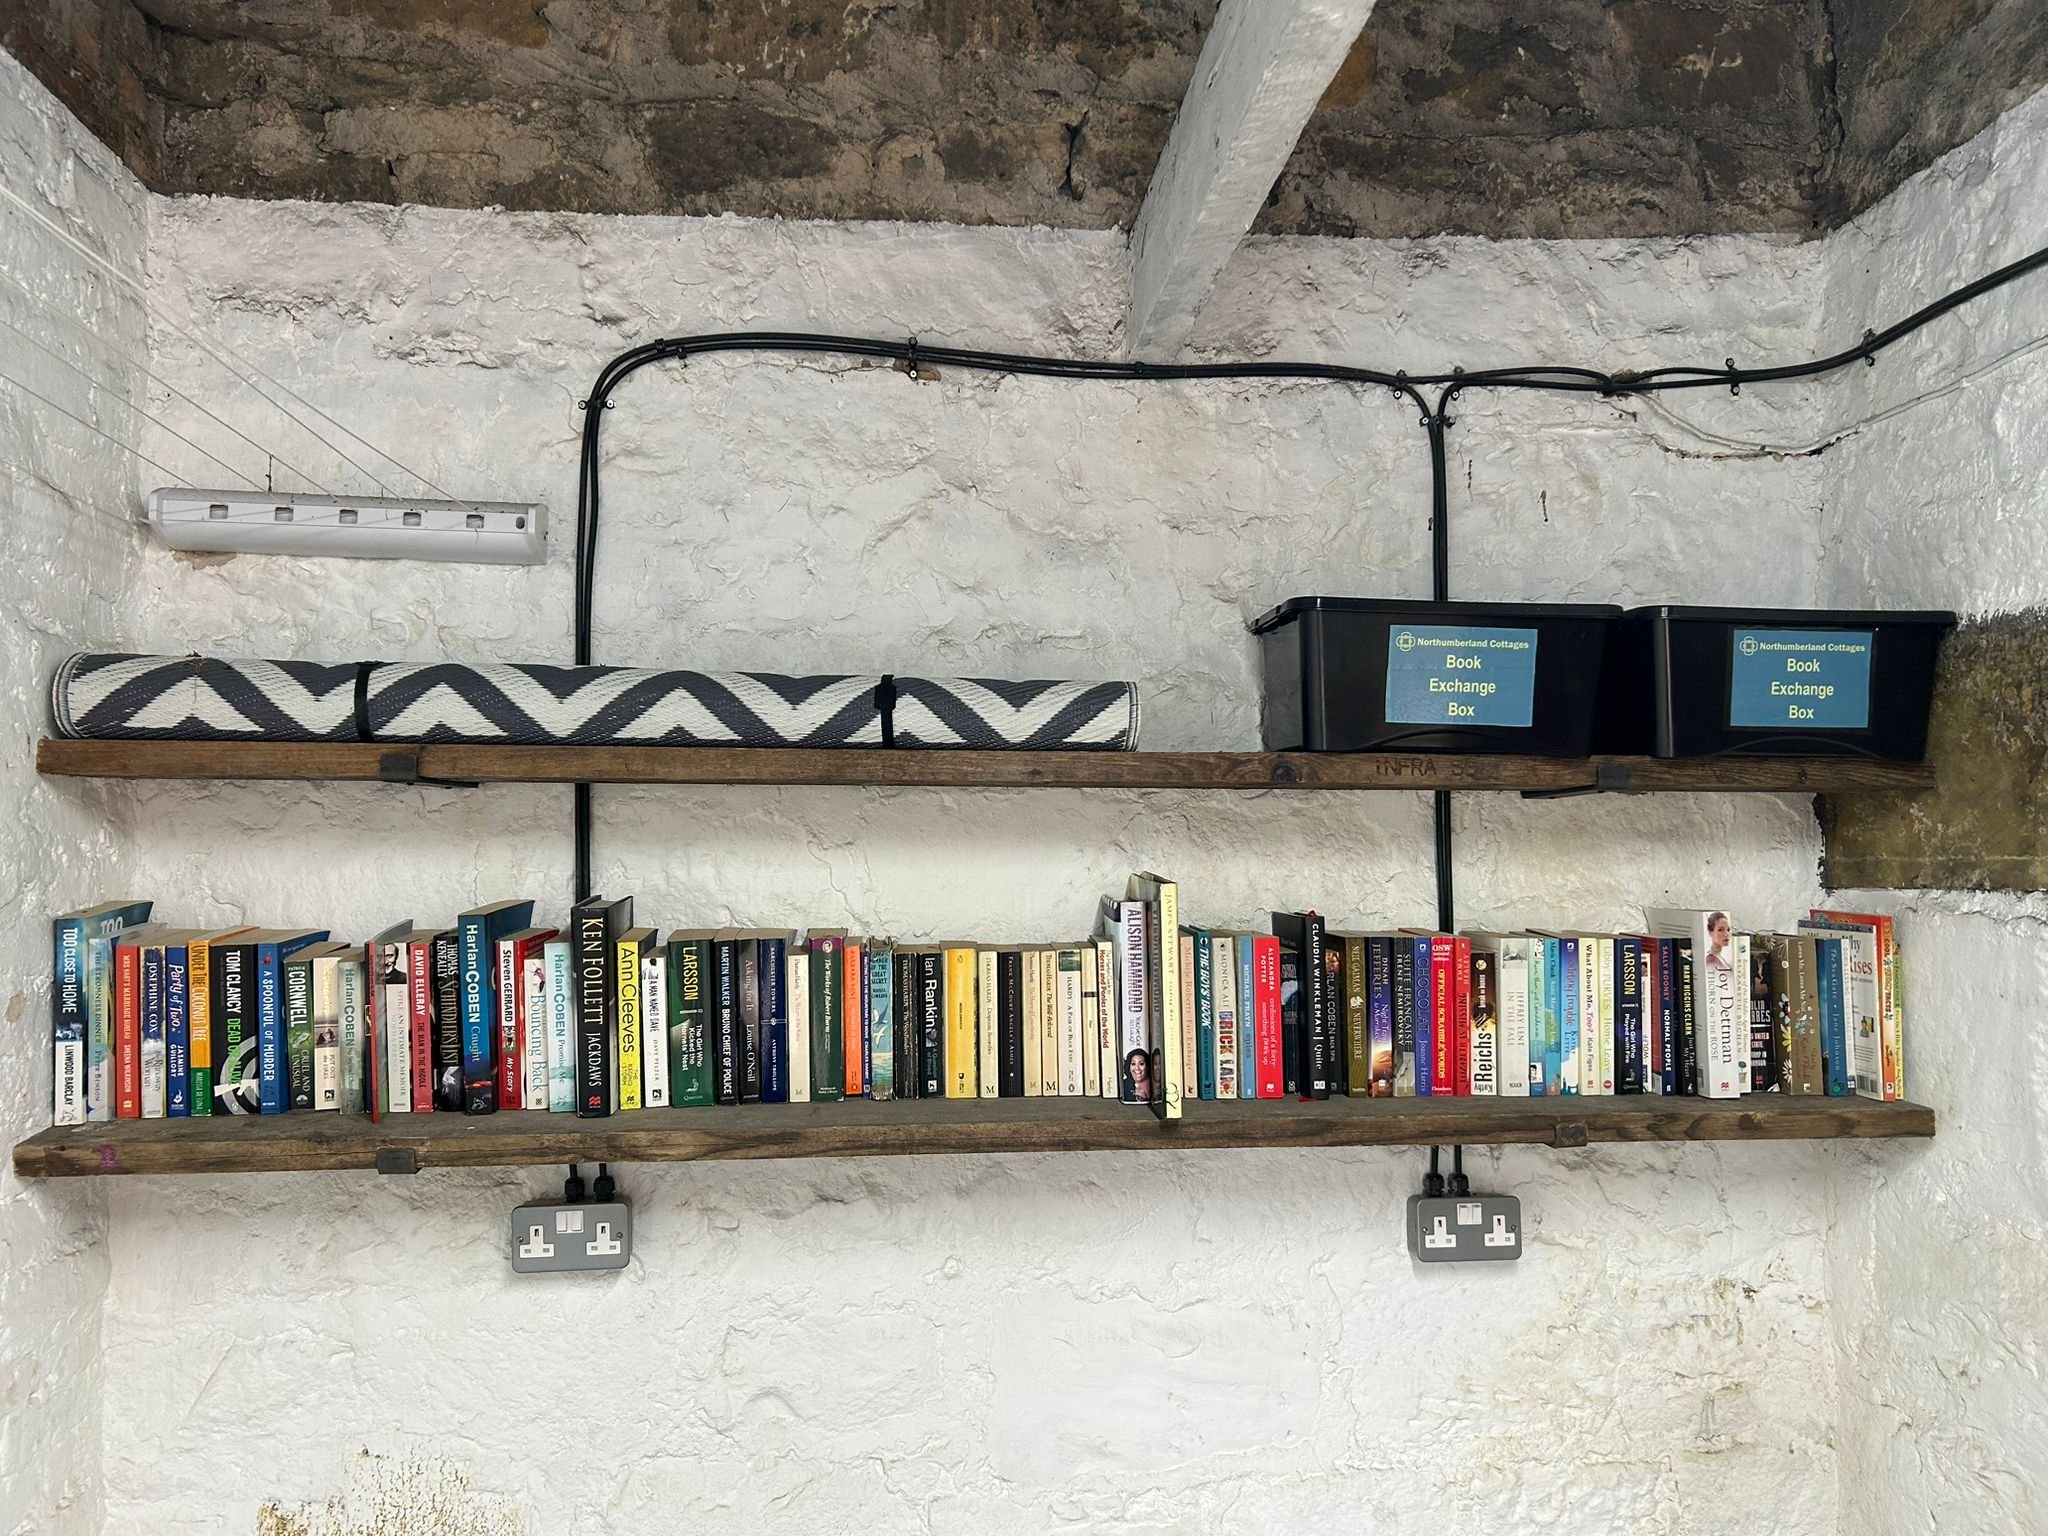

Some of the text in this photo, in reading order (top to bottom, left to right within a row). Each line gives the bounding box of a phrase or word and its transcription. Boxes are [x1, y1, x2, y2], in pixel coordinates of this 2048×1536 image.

[1418, 638, 1529, 650] Northumberland Cottages
[1446, 654, 1482, 669] Book
[1760, 642, 1865, 653] Northumberland Cottages
[1787, 658, 1820, 672] Book
[1429, 678, 1496, 696] Exchange
[1771, 682, 1834, 699] Exchange
[1448, 702, 1475, 716] Box
[1789, 705, 1814, 719] Box
[1376, 758, 1437, 776] INFRA
[62, 928, 78, 1013] TOO CLOSE TO HOME
[225, 950, 240, 972] TOM
[437, 940, 447, 978] KENEALLY
[447, 944, 458, 975] THOMAS
[465, 924, 480, 1023] Harlan COBEN
[582, 917, 604, 1024] KEN FOLLETT
[682, 946, 699, 1000] LARSSON
[721, 946, 730, 1006] MARTIN WALKER
[1098, 949, 1106, 971] Horses
[1126, 909, 1142, 1013] ALISON HAMMOND
[1200, 948, 1209, 969] THE
[1311, 923, 1323, 1033] CLAUDIA WINKLEMAN
[1352, 945, 1360, 992] NEIL GAIMAN
[1372, 944, 1382, 999] JEFFERIES
[1623, 945, 1635, 995] LARSSON
[146, 962, 158, 1033] JOSEPHINE COX
[226, 974, 241, 1013] CLANCY
[263, 979, 273, 1027] SPOONFUL
[289, 971, 306, 1027] CORNWELL
[415, 949, 425, 1015] DAVID ELLERAY
[503, 949, 513, 1022] Steven GERRARD
[554, 954, 565, 1036] Harlan COBEN
[622, 948, 638, 1053] Ann Cleeves
[924, 957, 937, 1028] Ian Rankin
[1100, 986, 1108, 1007] Ponies
[1200, 969, 1210, 996] BOYS'
[1417, 958, 1429, 1033] CHOCOLAT
[1585, 995, 1593, 1011] Me,
[1683, 965, 1692, 1035] MARY HIGGINS CLARK
[344, 969, 355, 1047] Harlan COBEN
[417, 1022, 425, 1032] THE
[529, 994, 546, 1056] Bouncing
[1101, 1009, 1109, 1017] of
[1201, 999, 1210, 1029] BOOK
[1438, 969, 1446, 1079] OFFICIAL SCRABBLE WORDS
[1516, 991, 1524, 1021] JEFFREY
[1715, 967, 1734, 1064] Joy Dettman
[264, 1030, 273, 1040] OF
[471, 1026, 480, 1062] Caught
[722, 1009, 731, 1094] BRUNO CHIEF OF POLICE
[746, 1024, 755, 1082] Louise O'Neill
[1102, 1028, 1110, 1048] World
[1244, 1033, 1252, 1058] spies
[1353, 1013, 1361, 1060] NEVERWHERE
[1832, 1013, 1841, 1071] Jane Johnson
[64, 1045, 74, 1105] LINWOOD BARCLAY
[263, 1044, 274, 1081] MURDER
[292, 1054, 300, 1088] UNUSUAL
[301, 1049, 310, 1091] CRUEL AND
[418, 1054, 426, 1066] THE
[506, 1057, 514, 1092] My Story
[532, 1060, 547, 1091] Back
[586, 1032, 602, 1086] JACKDAWS
[1315, 1044, 1324, 1070] Quite
[1419, 1039, 1429, 1091] Joanne Harris
[1474, 1032, 1492, 1082] Reichs
